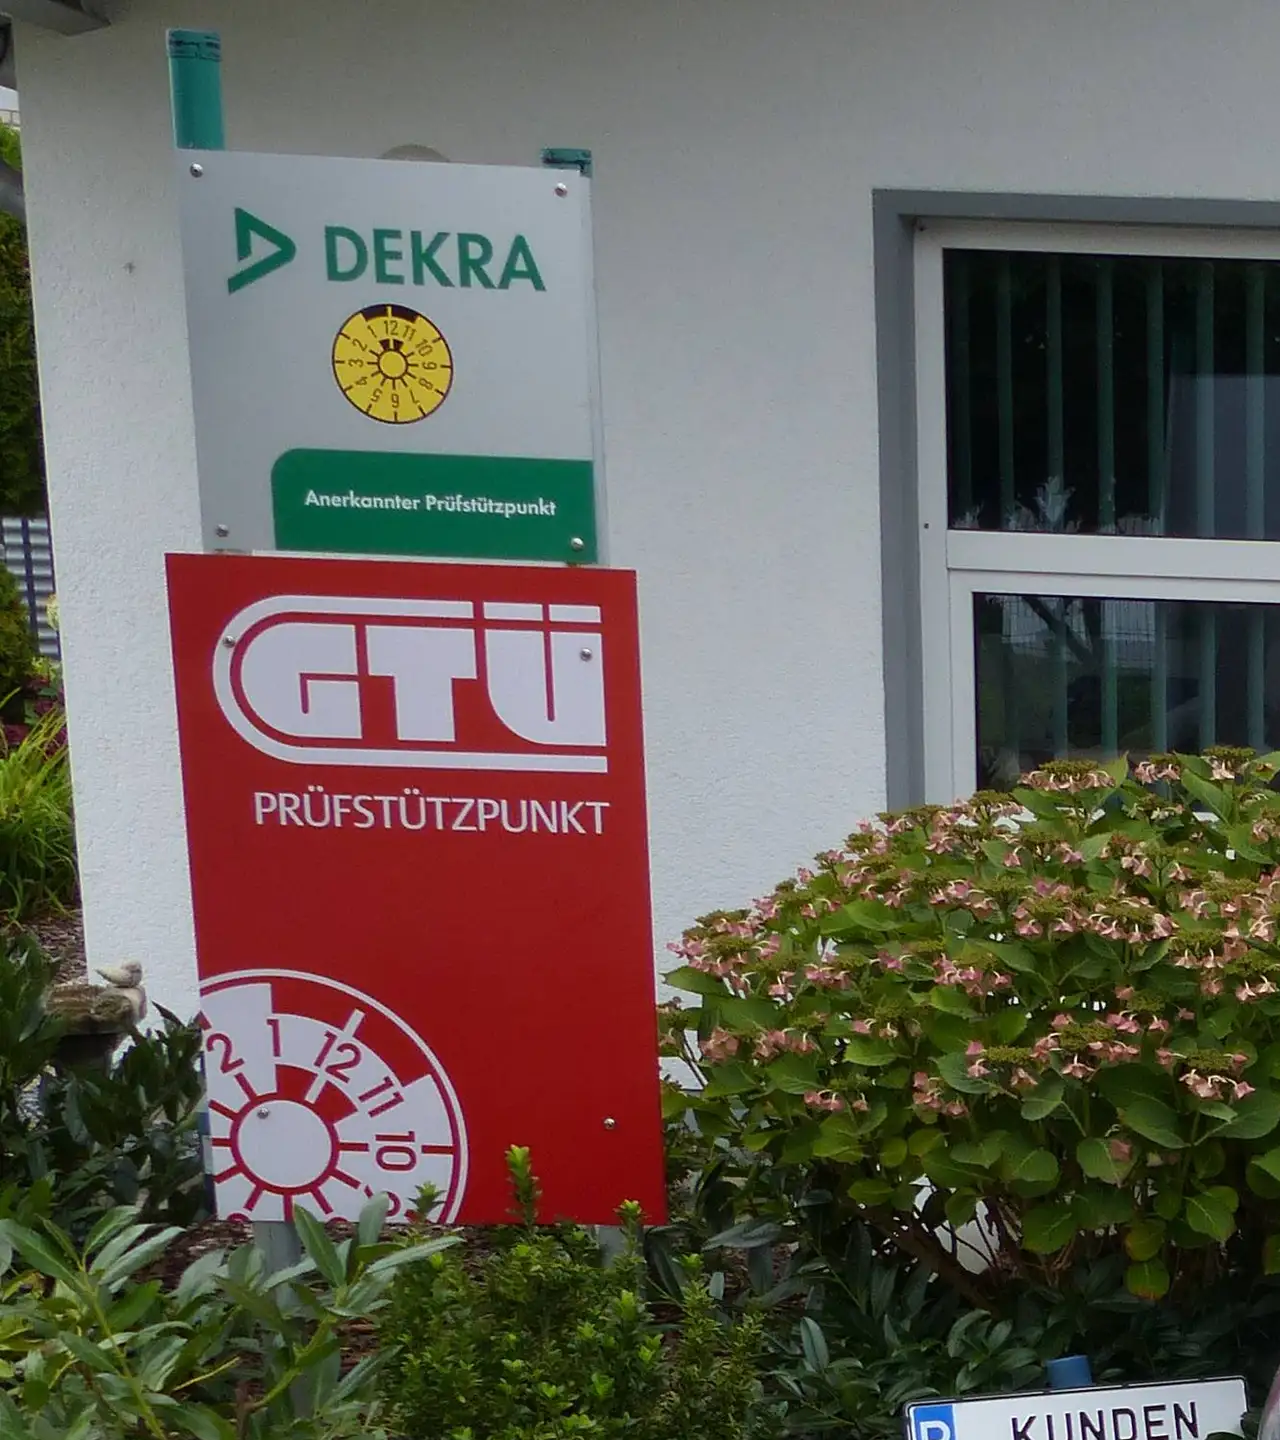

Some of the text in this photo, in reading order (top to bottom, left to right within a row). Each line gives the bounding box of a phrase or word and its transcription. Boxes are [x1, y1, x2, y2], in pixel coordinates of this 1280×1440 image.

[324, 225, 547, 292] DEKRA
[366, 325, 378, 339] 1
[383, 320, 399, 336] 12
[402, 324, 417, 341] 11
[351, 338, 368, 352] 2
[415, 338, 434, 357] 10
[347, 358, 364, 368] 3
[409, 389, 420, 405] 7
[418, 377, 434, 391] 8
[304, 489, 557, 518] Anerkannter Prüfstützpunkt
[213, 595, 608, 752] GTÜ
[253, 785, 610, 835] PRÜFSTÜTZPUNKT
[266, 1018, 281, 1058] 1
[206, 1032, 245, 1075] 2
[314, 1029, 363, 1084] 12
[358, 1076, 406, 1119] 11
[374, 1130, 417, 1173] 10
